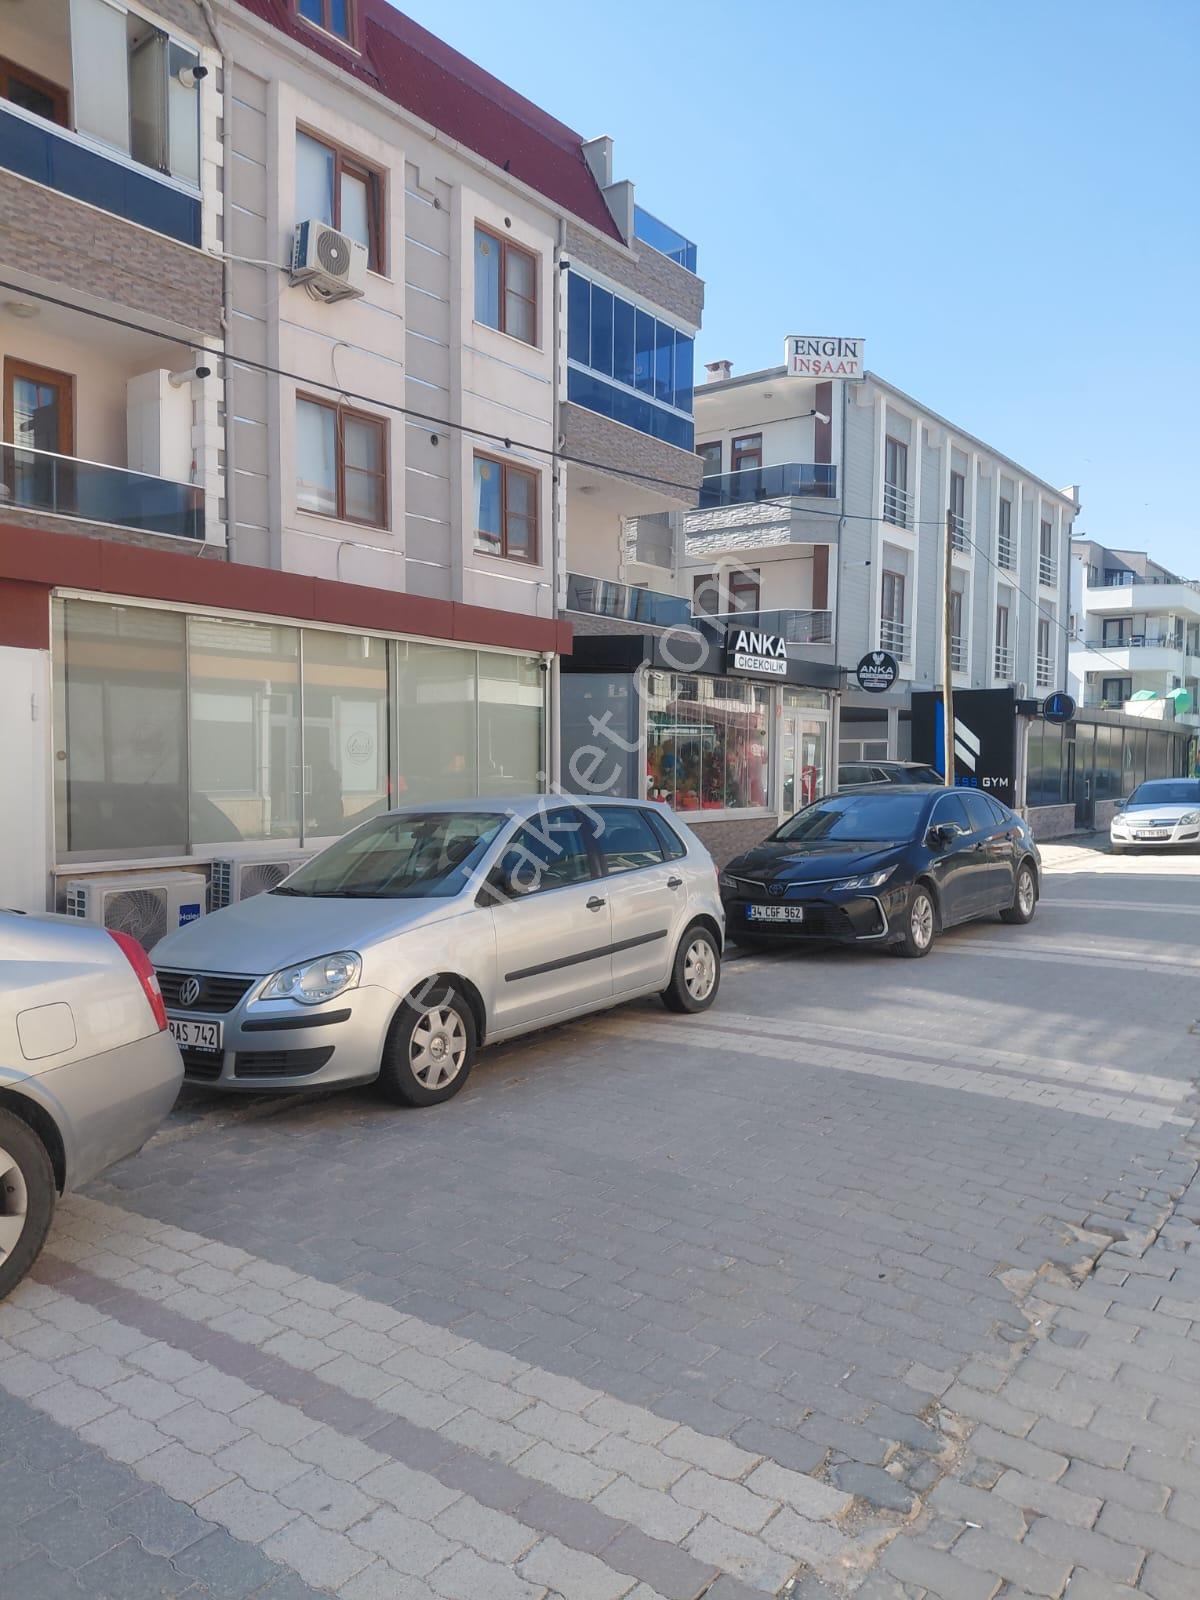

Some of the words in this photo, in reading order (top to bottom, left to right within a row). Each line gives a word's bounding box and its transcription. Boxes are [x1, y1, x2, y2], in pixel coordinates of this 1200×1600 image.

[735, 630, 788, 658] ANKA
[860, 665, 894, 674] ANKA
[982, 777, 1009, 787] GYM
[752, 907, 762, 917] 34
[784, 908, 801, 919] 962
[194, 1025, 215, 1046] 742
